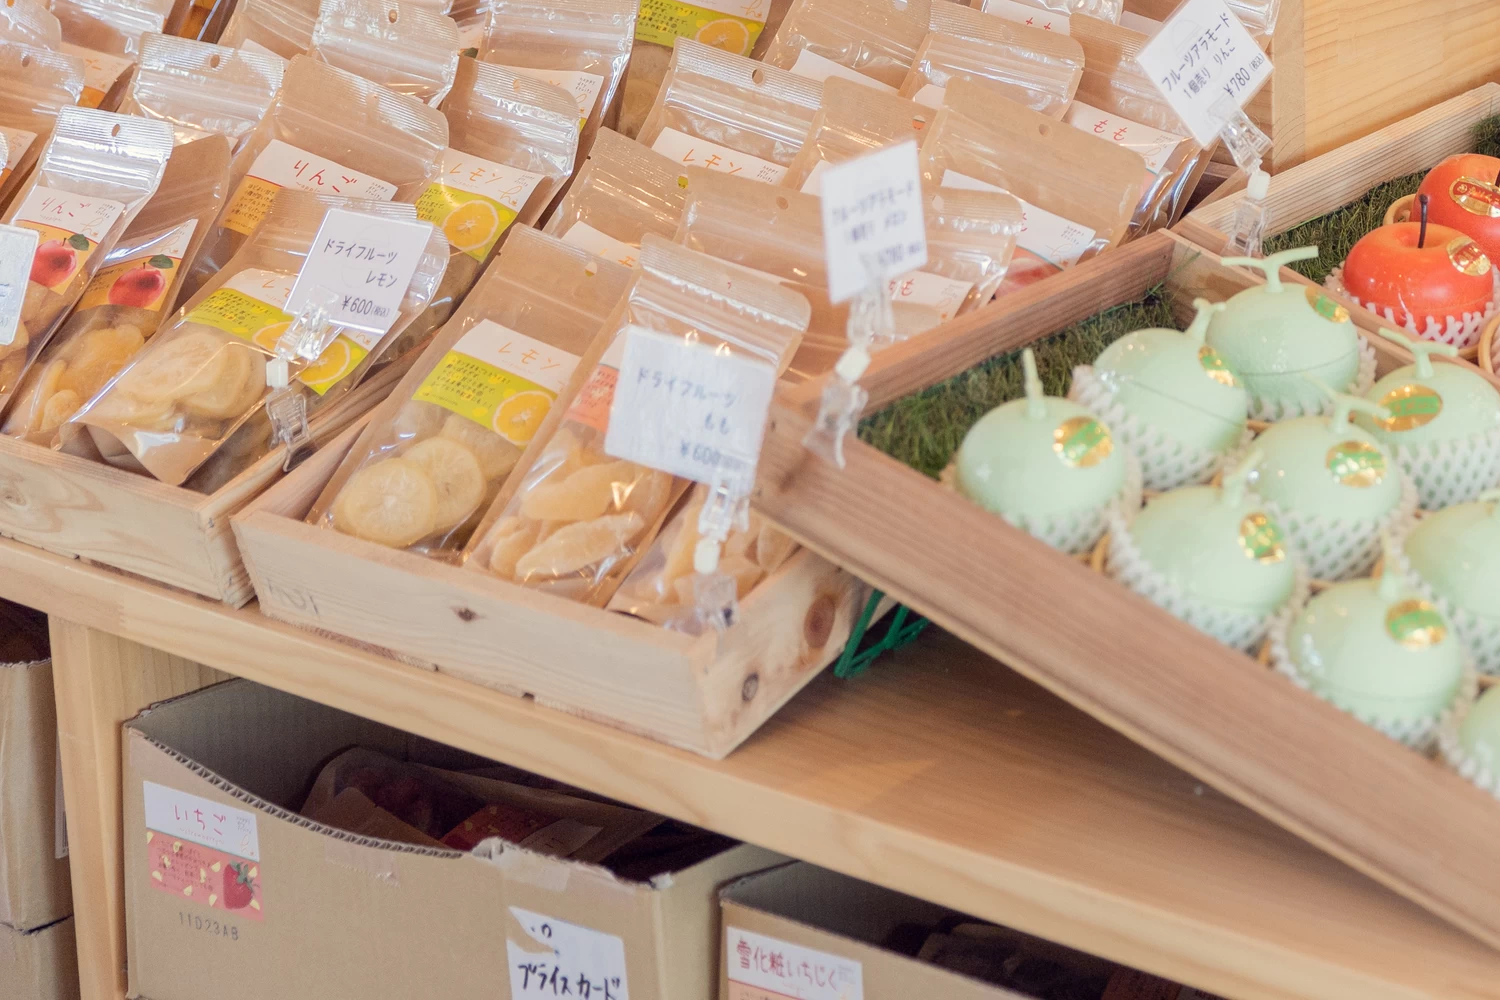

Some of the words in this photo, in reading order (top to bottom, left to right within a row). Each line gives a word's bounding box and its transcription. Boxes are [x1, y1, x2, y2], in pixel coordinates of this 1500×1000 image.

[1161, 12, 1230, 92] フルーツアラモード
[1183, 66, 1211, 99] 1個売り
[1223, 67, 1251, 98] ¥780
[1094, 119, 1128, 142] もも
[449, 163, 503, 184] レモン
[683, 148, 742, 174] レモン
[293, 159, 358, 193] りんご
[42, 197, 91, 218] りんご
[324, 239, 398, 265] ドライフルーツ
[365, 270, 398, 288] レモン
[342, 295, 373, 316] ¥600
[498, 342, 561, 371] レモン
[637, 366, 738, 408] ドライフルーツ
[704, 411, 730, 436] もも
[174, 805, 226, 836] いちご
[736, 937, 837, 991] 雪化粧いちじく
